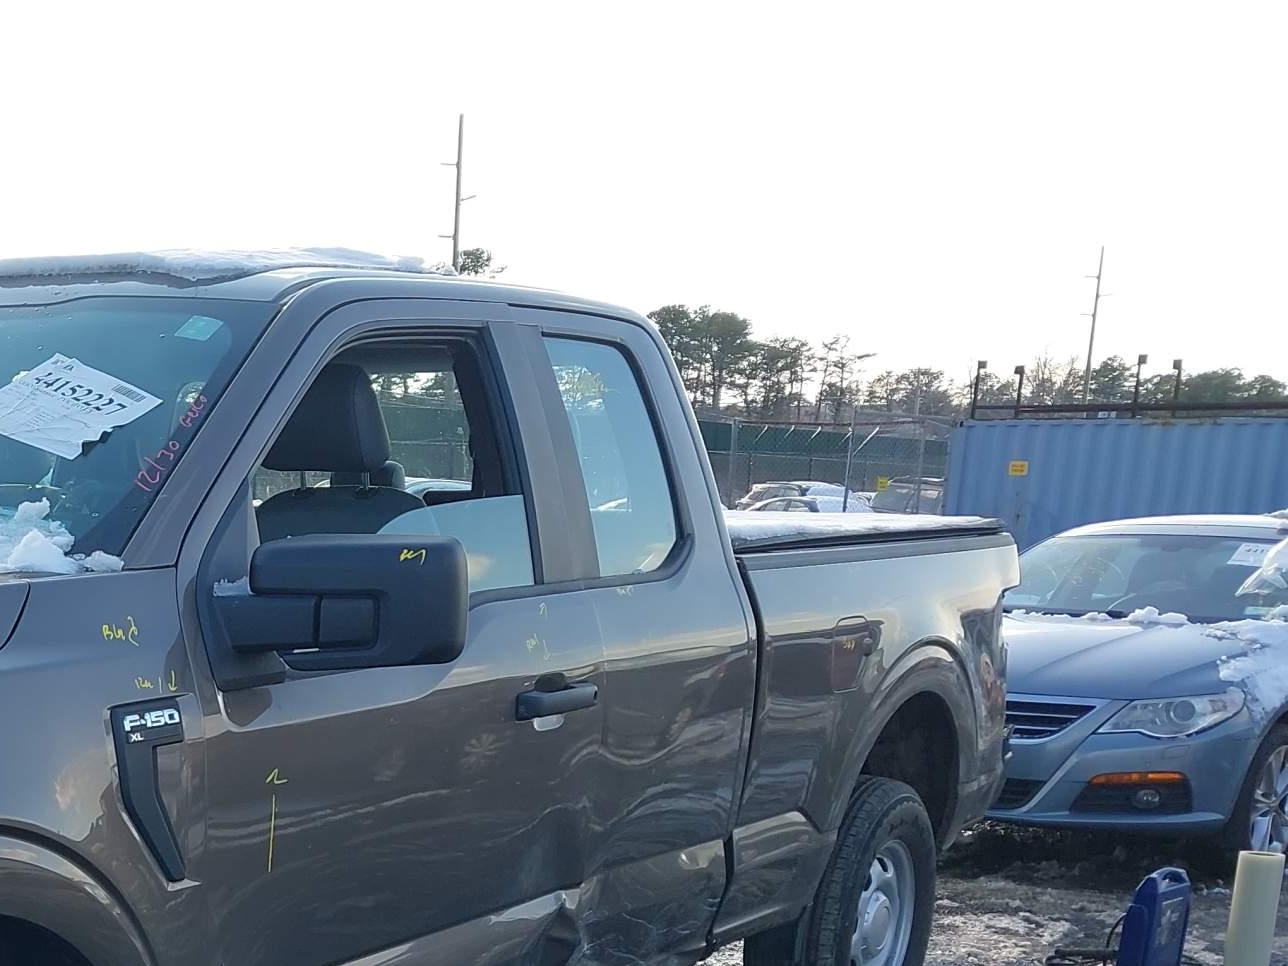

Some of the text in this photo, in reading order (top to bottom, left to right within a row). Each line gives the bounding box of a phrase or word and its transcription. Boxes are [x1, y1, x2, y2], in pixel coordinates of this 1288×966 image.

[34, 372, 128, 416] 44152227
[123, 708, 180, 732] F-150
[128, 732, 145, 743] XL
